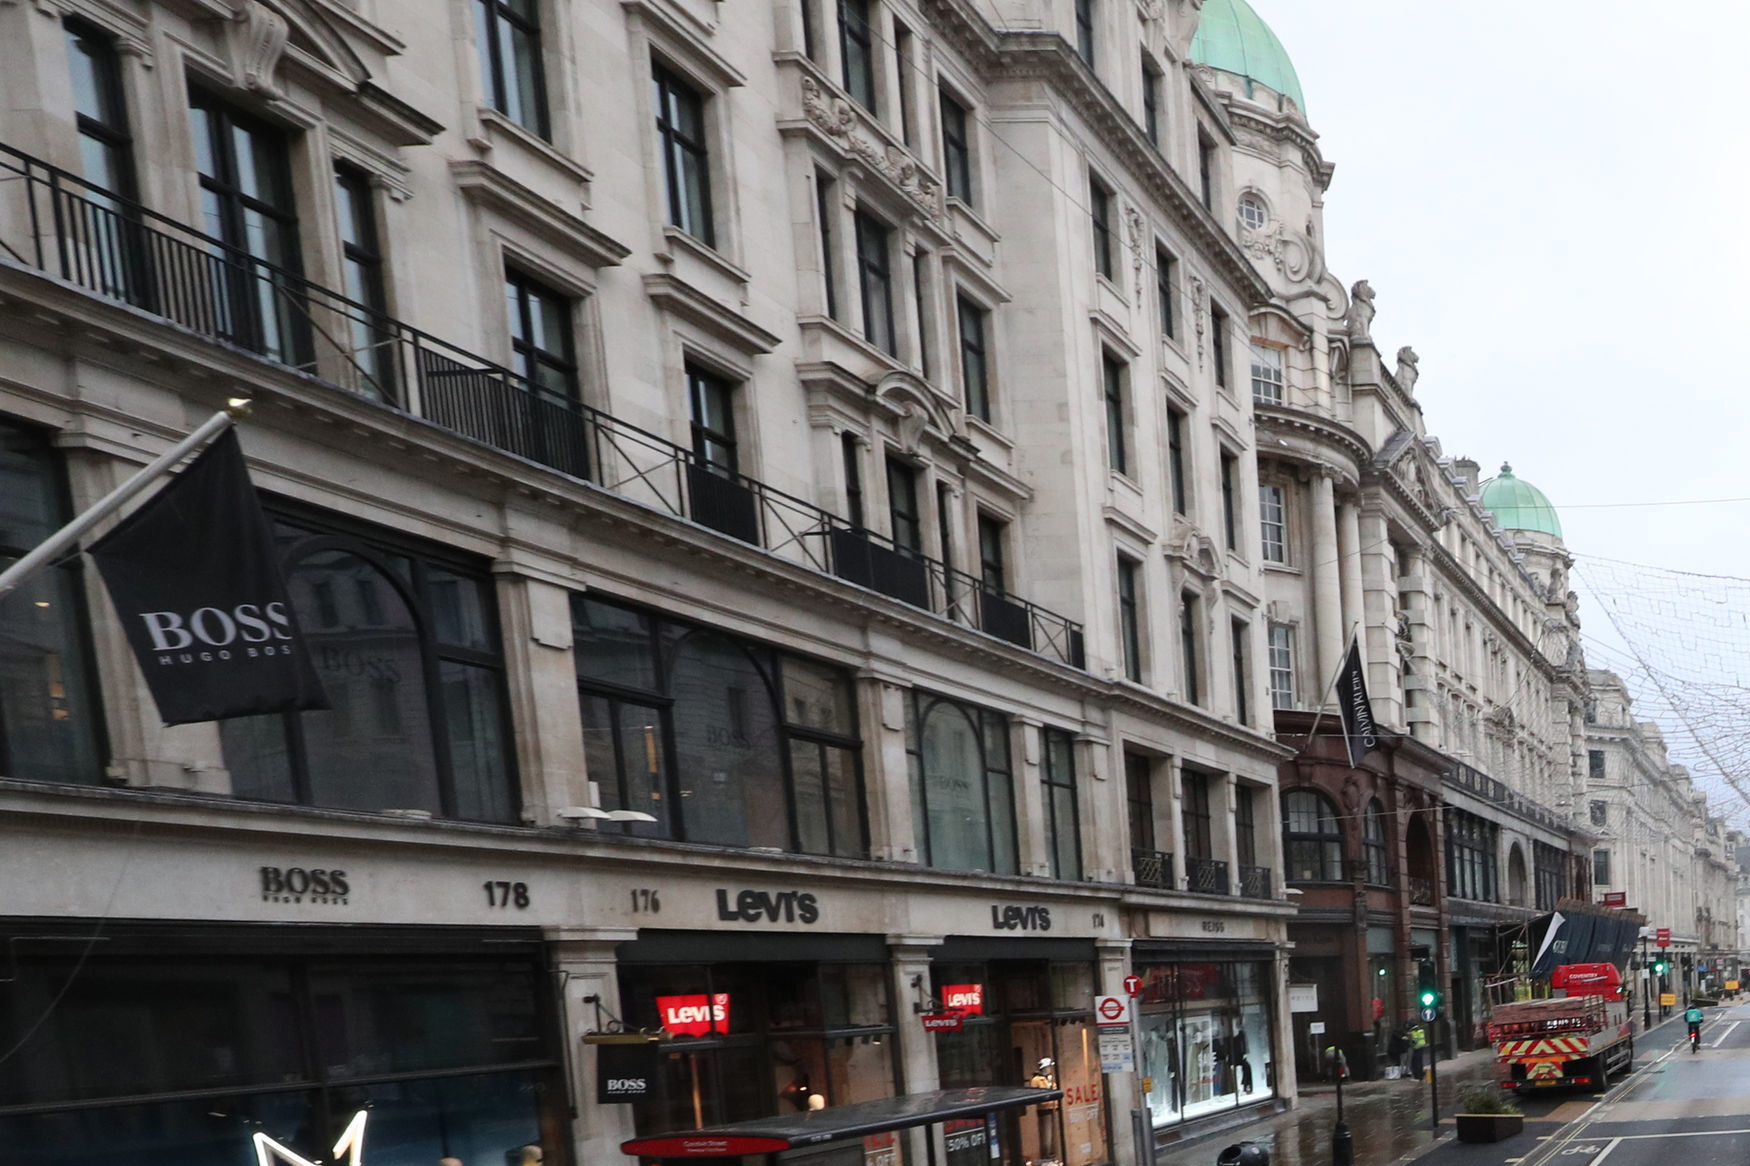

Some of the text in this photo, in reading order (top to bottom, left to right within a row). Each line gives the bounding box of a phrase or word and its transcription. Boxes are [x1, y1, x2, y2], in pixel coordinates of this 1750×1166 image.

[138, 602, 293, 650] BOSS
[159, 645, 291, 665] HUGO BOS
[1355, 705, 1376, 748] CALVIN
[261, 866, 350, 895] BOSS
[483, 880, 530, 909] 178
[630, 888, 661, 914] 176
[667, 1004, 726, 1024] Levis
[607, 1078, 647, 1091] BOSS
[1067, 1084, 1099, 1105] SALE
